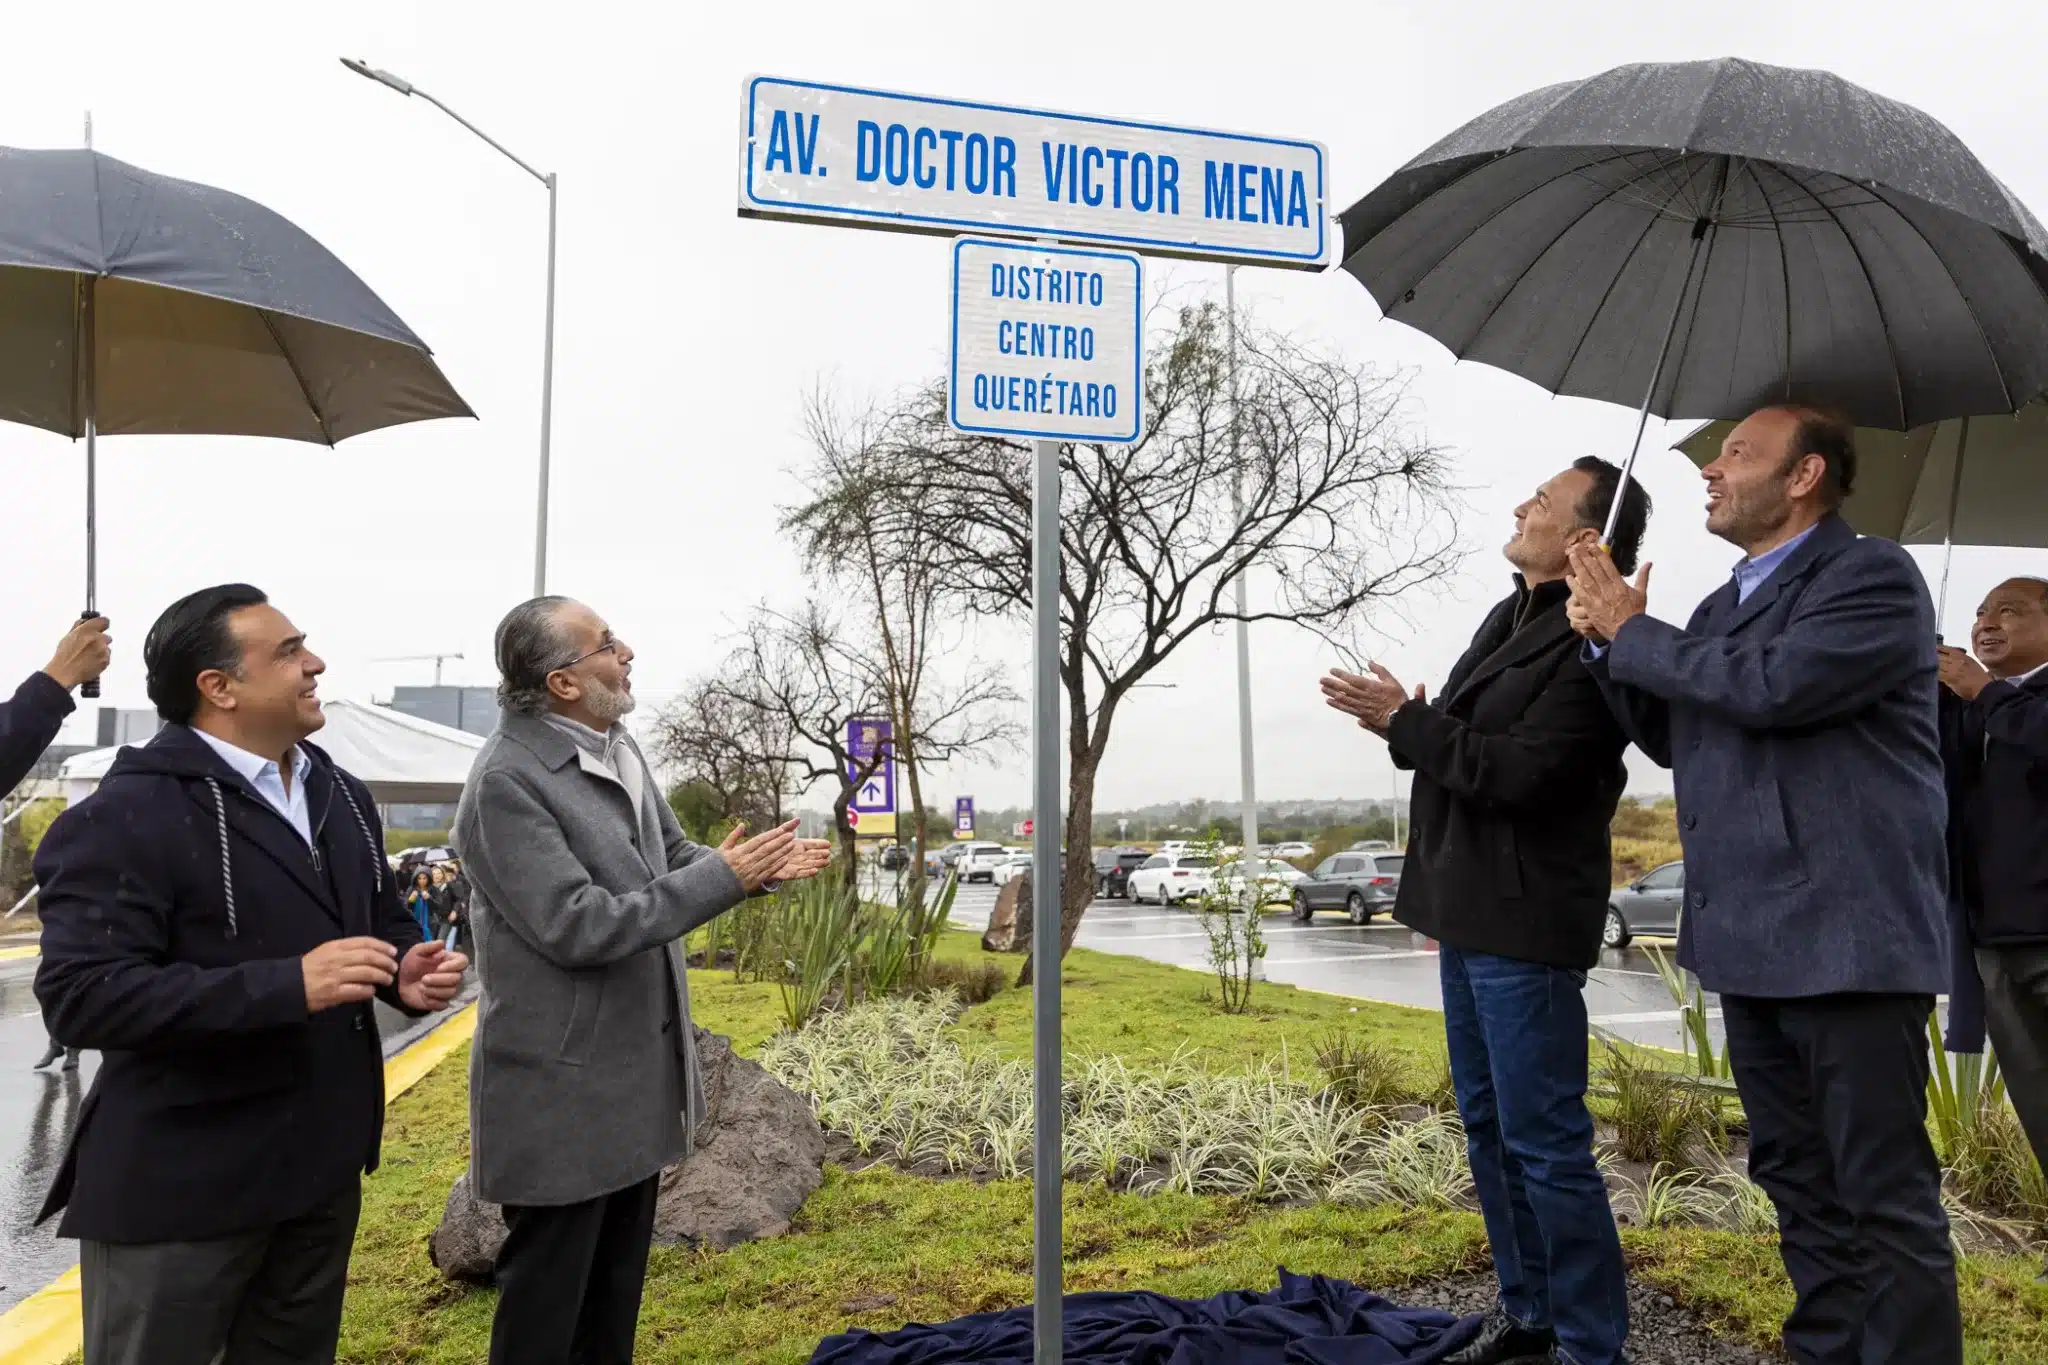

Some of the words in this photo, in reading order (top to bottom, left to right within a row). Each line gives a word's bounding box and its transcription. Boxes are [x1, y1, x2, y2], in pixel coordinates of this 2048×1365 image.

[764, 108, 828, 177] AV.
[855, 119, 1017, 199] DOCTOR
[1040, 140, 1181, 217] VICTOR
[1203, 159, 1311, 230] MENA
[990, 262, 1104, 309] DISTRITO
[997, 319, 1095, 361] CENTRO
[973, 370, 1118, 419] QUERÉTARO
